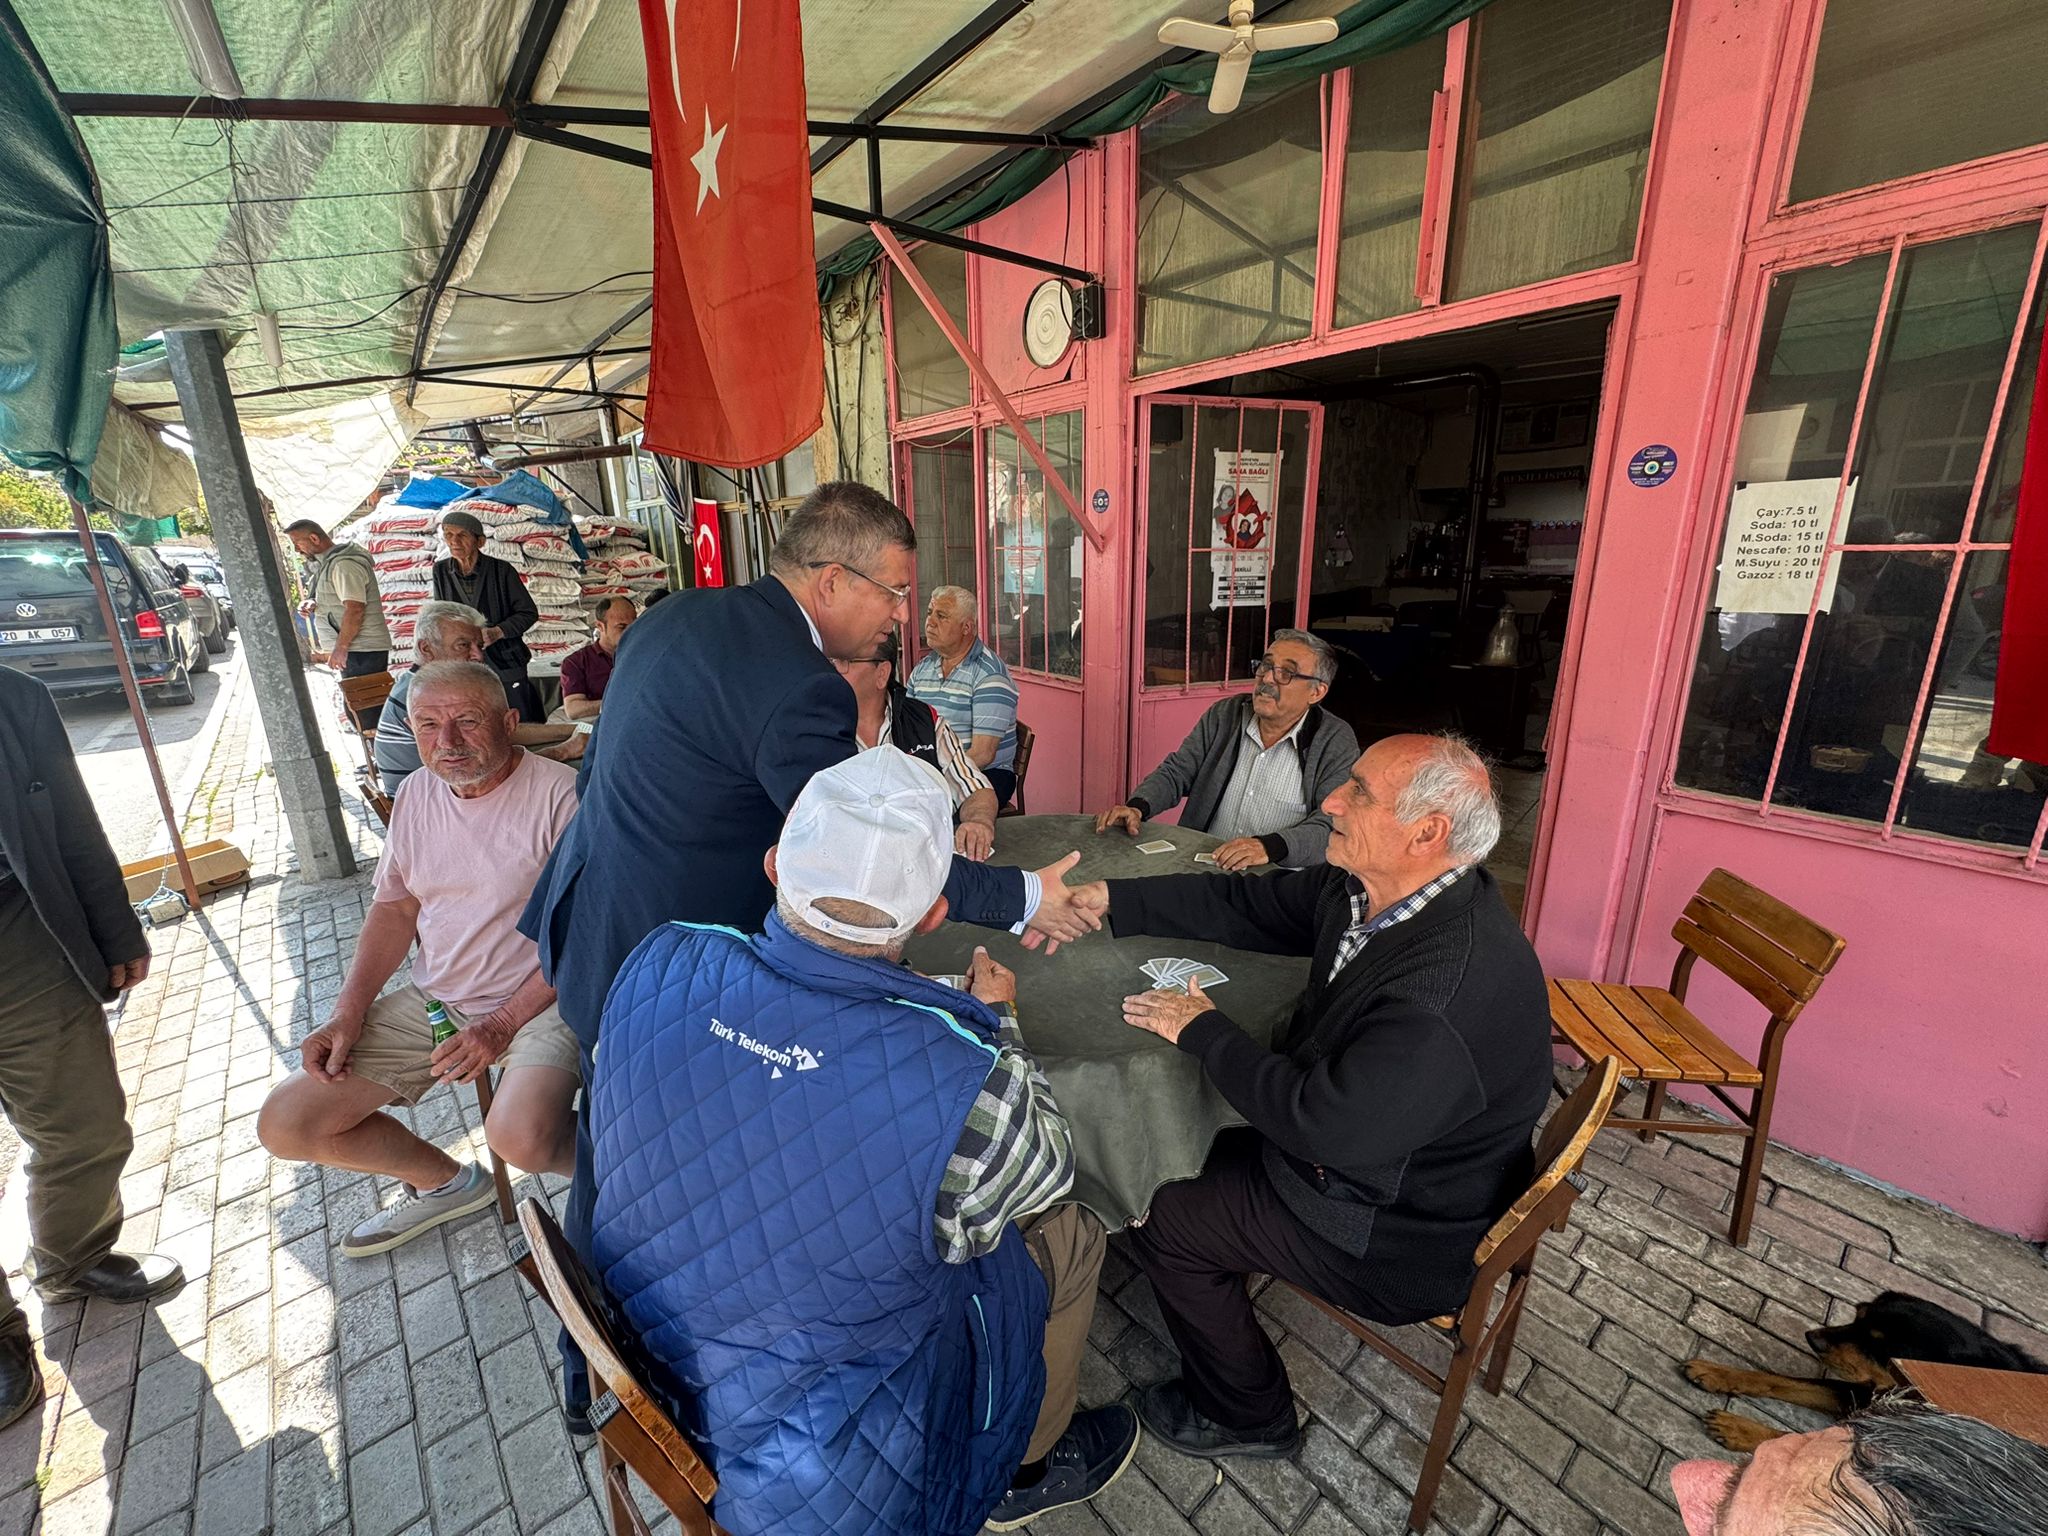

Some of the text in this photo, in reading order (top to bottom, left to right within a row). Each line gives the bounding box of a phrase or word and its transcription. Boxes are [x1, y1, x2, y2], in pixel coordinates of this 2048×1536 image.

[1808, 506, 1817, 515] tl
[1750, 519, 1818, 530] Soda: 10 tl
[1741, 531, 1824, 543] M.Soda: 15 tl
[1737, 544, 1823, 555] Nescafe: 10 tl
[1735, 558, 1780, 569] M.Suyu
[1792, 557, 1807, 567] 20
[1811, 557, 1820, 566] tl
[1737, 571, 1774, 579] Gazoz
[1786, 570, 1801, 579] 18
[1805, 570, 1814, 579] tl
[2, 628, 71, 640] 20 AK 057
[709, 1018, 791, 1067] Türk Telekom
